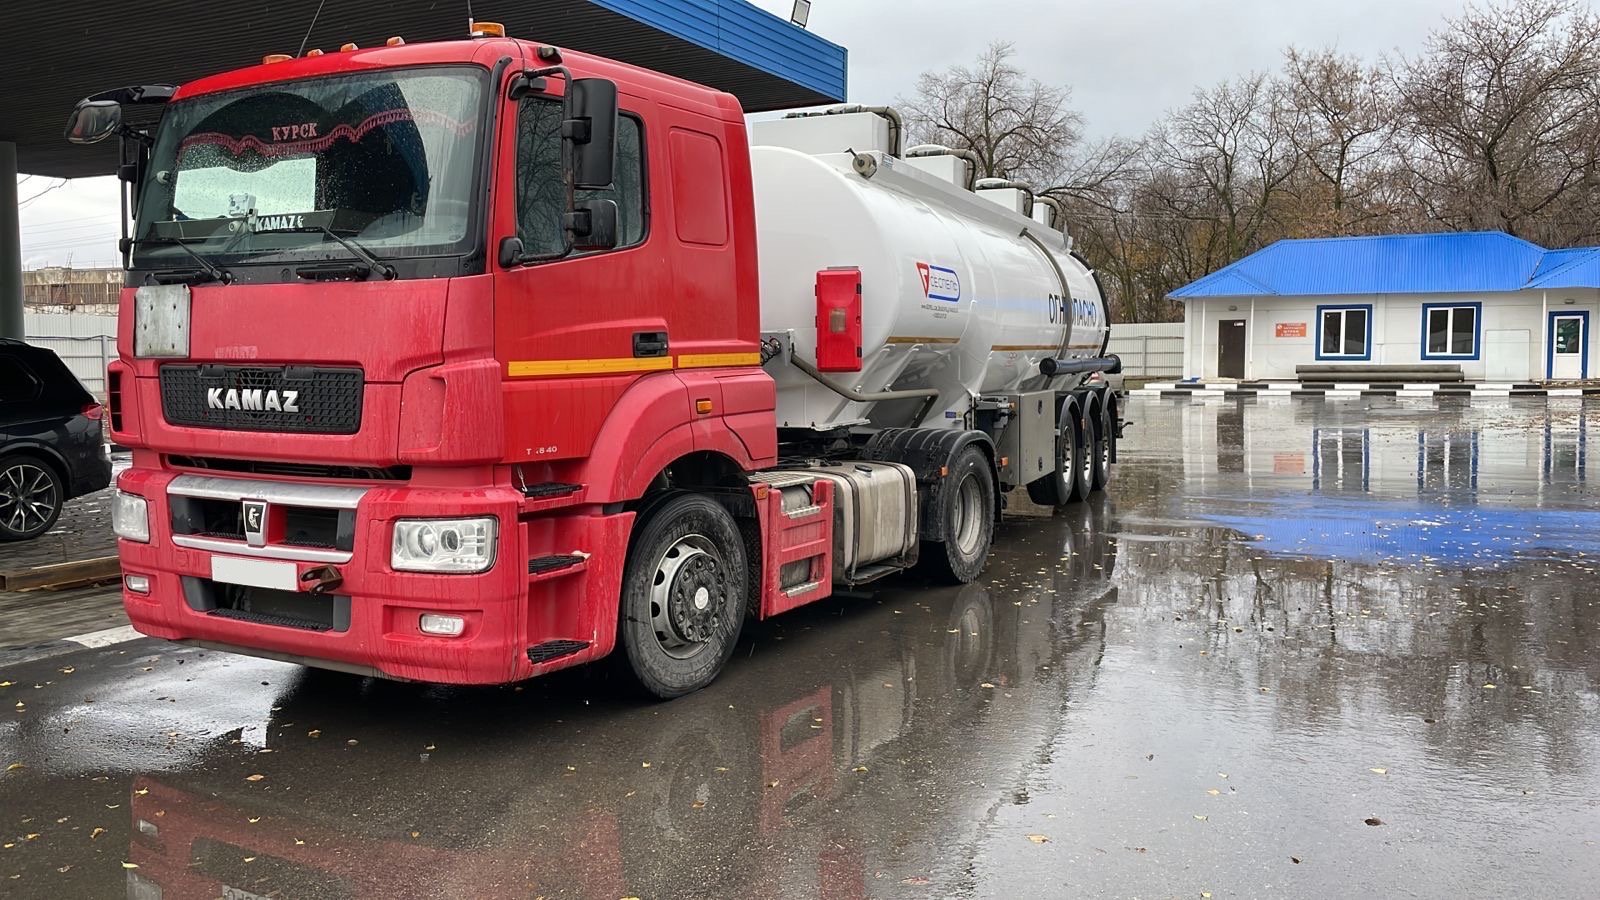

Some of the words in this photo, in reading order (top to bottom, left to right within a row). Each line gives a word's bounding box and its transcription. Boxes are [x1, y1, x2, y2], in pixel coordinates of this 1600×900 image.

[272, 122, 318, 140] КУРСК
[256, 215, 296, 232] KAMAZ
[1049, 293, 1097, 327] ОГНПАСНО
[207, 387, 299, 413] KAMAZ
